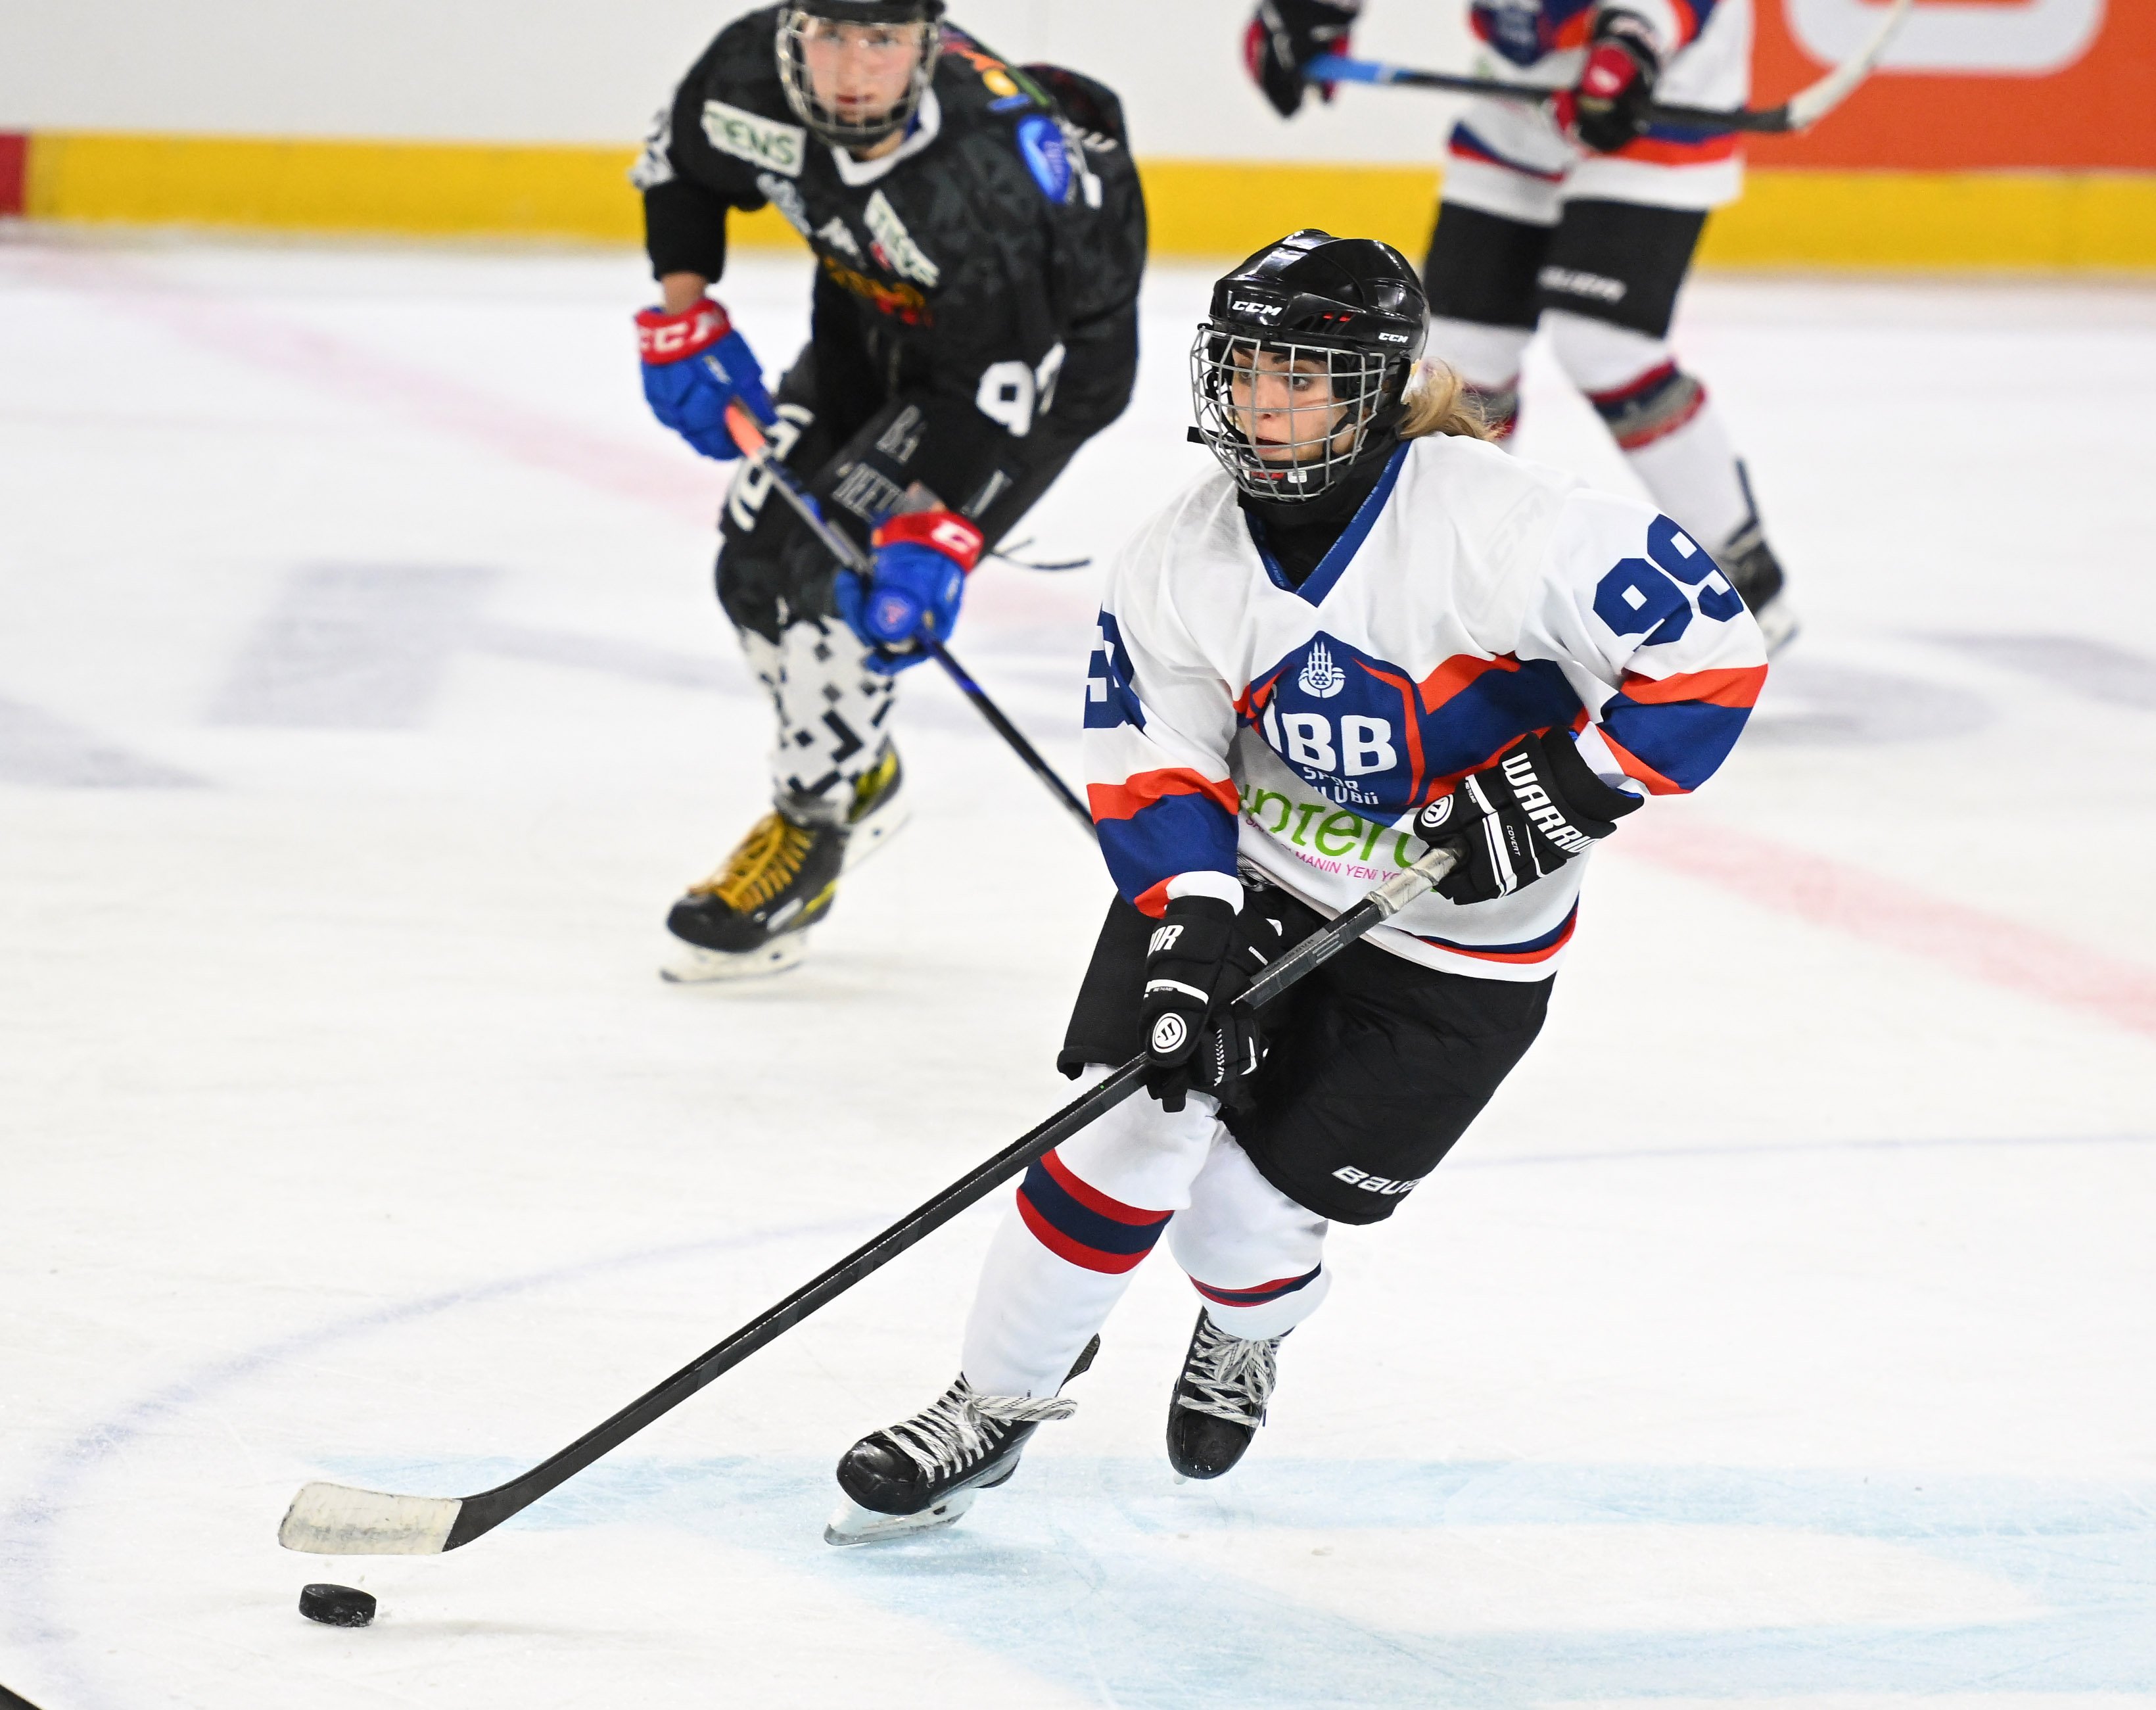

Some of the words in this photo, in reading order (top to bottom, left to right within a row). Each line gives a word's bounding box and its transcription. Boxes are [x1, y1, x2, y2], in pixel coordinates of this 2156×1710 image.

[1232, 300, 1283, 316] CCM
[1378, 332, 1409, 343] CCM
[1593, 513, 1744, 652] 99
[1507, 825, 1521, 857] COVERT
